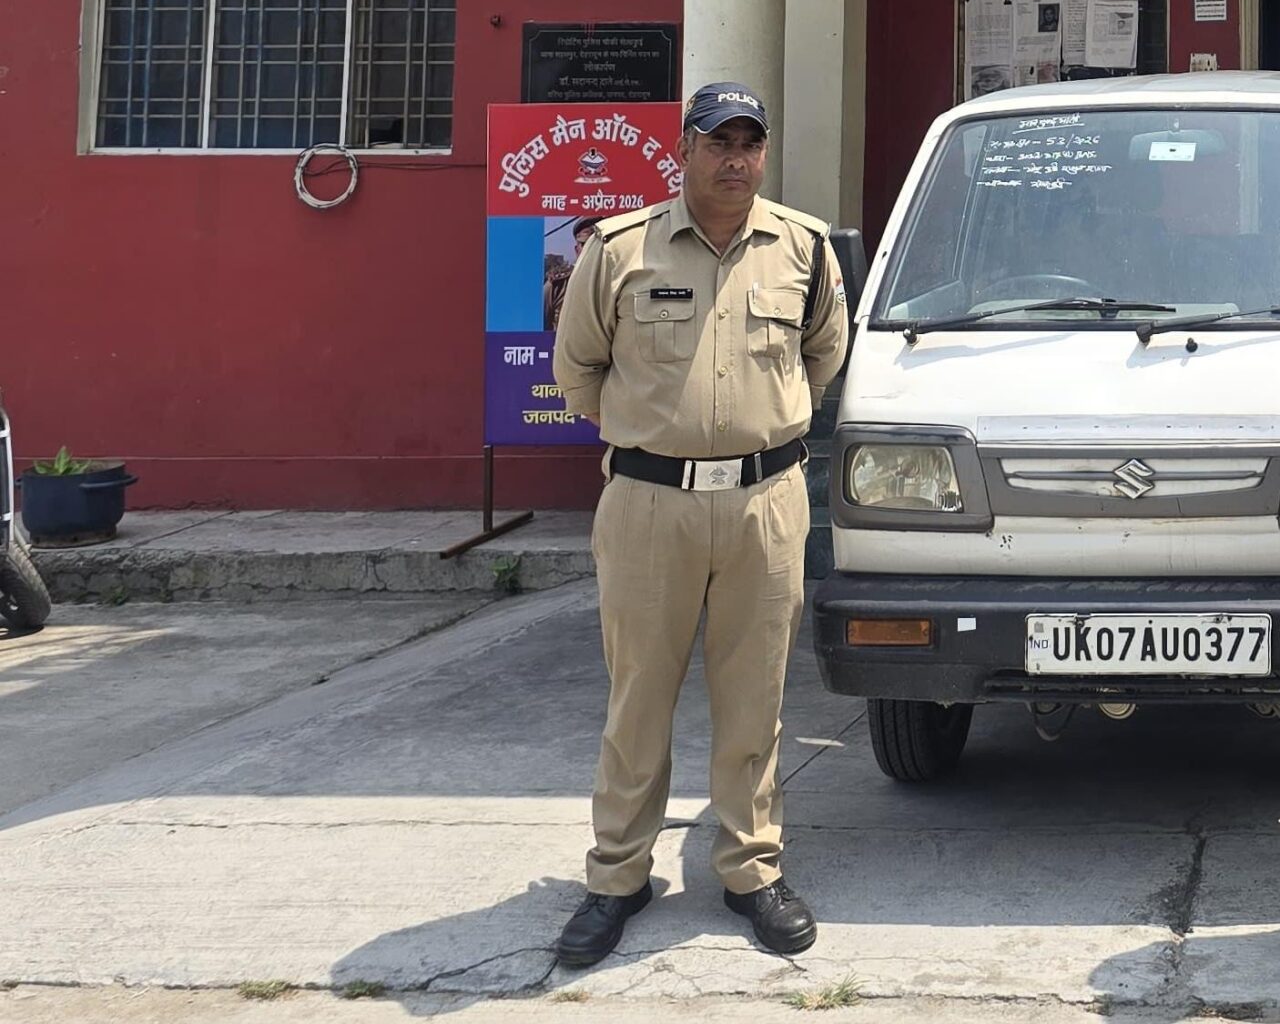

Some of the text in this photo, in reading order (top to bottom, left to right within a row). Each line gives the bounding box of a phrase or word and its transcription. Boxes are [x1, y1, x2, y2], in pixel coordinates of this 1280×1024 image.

[499, 135, 550, 198] पुलिस
[592, 113, 641, 146] ऑफ
[642, 137, 662, 161] द
[541, 195, 567, 211] माह
[618, 195, 644, 209] 2026
[503, 346, 535, 365] नाम
[531, 384, 562, 398] थान
[1029, 638, 1049, 649] IND
[1053, 626, 1266, 662] UK07AU0377
